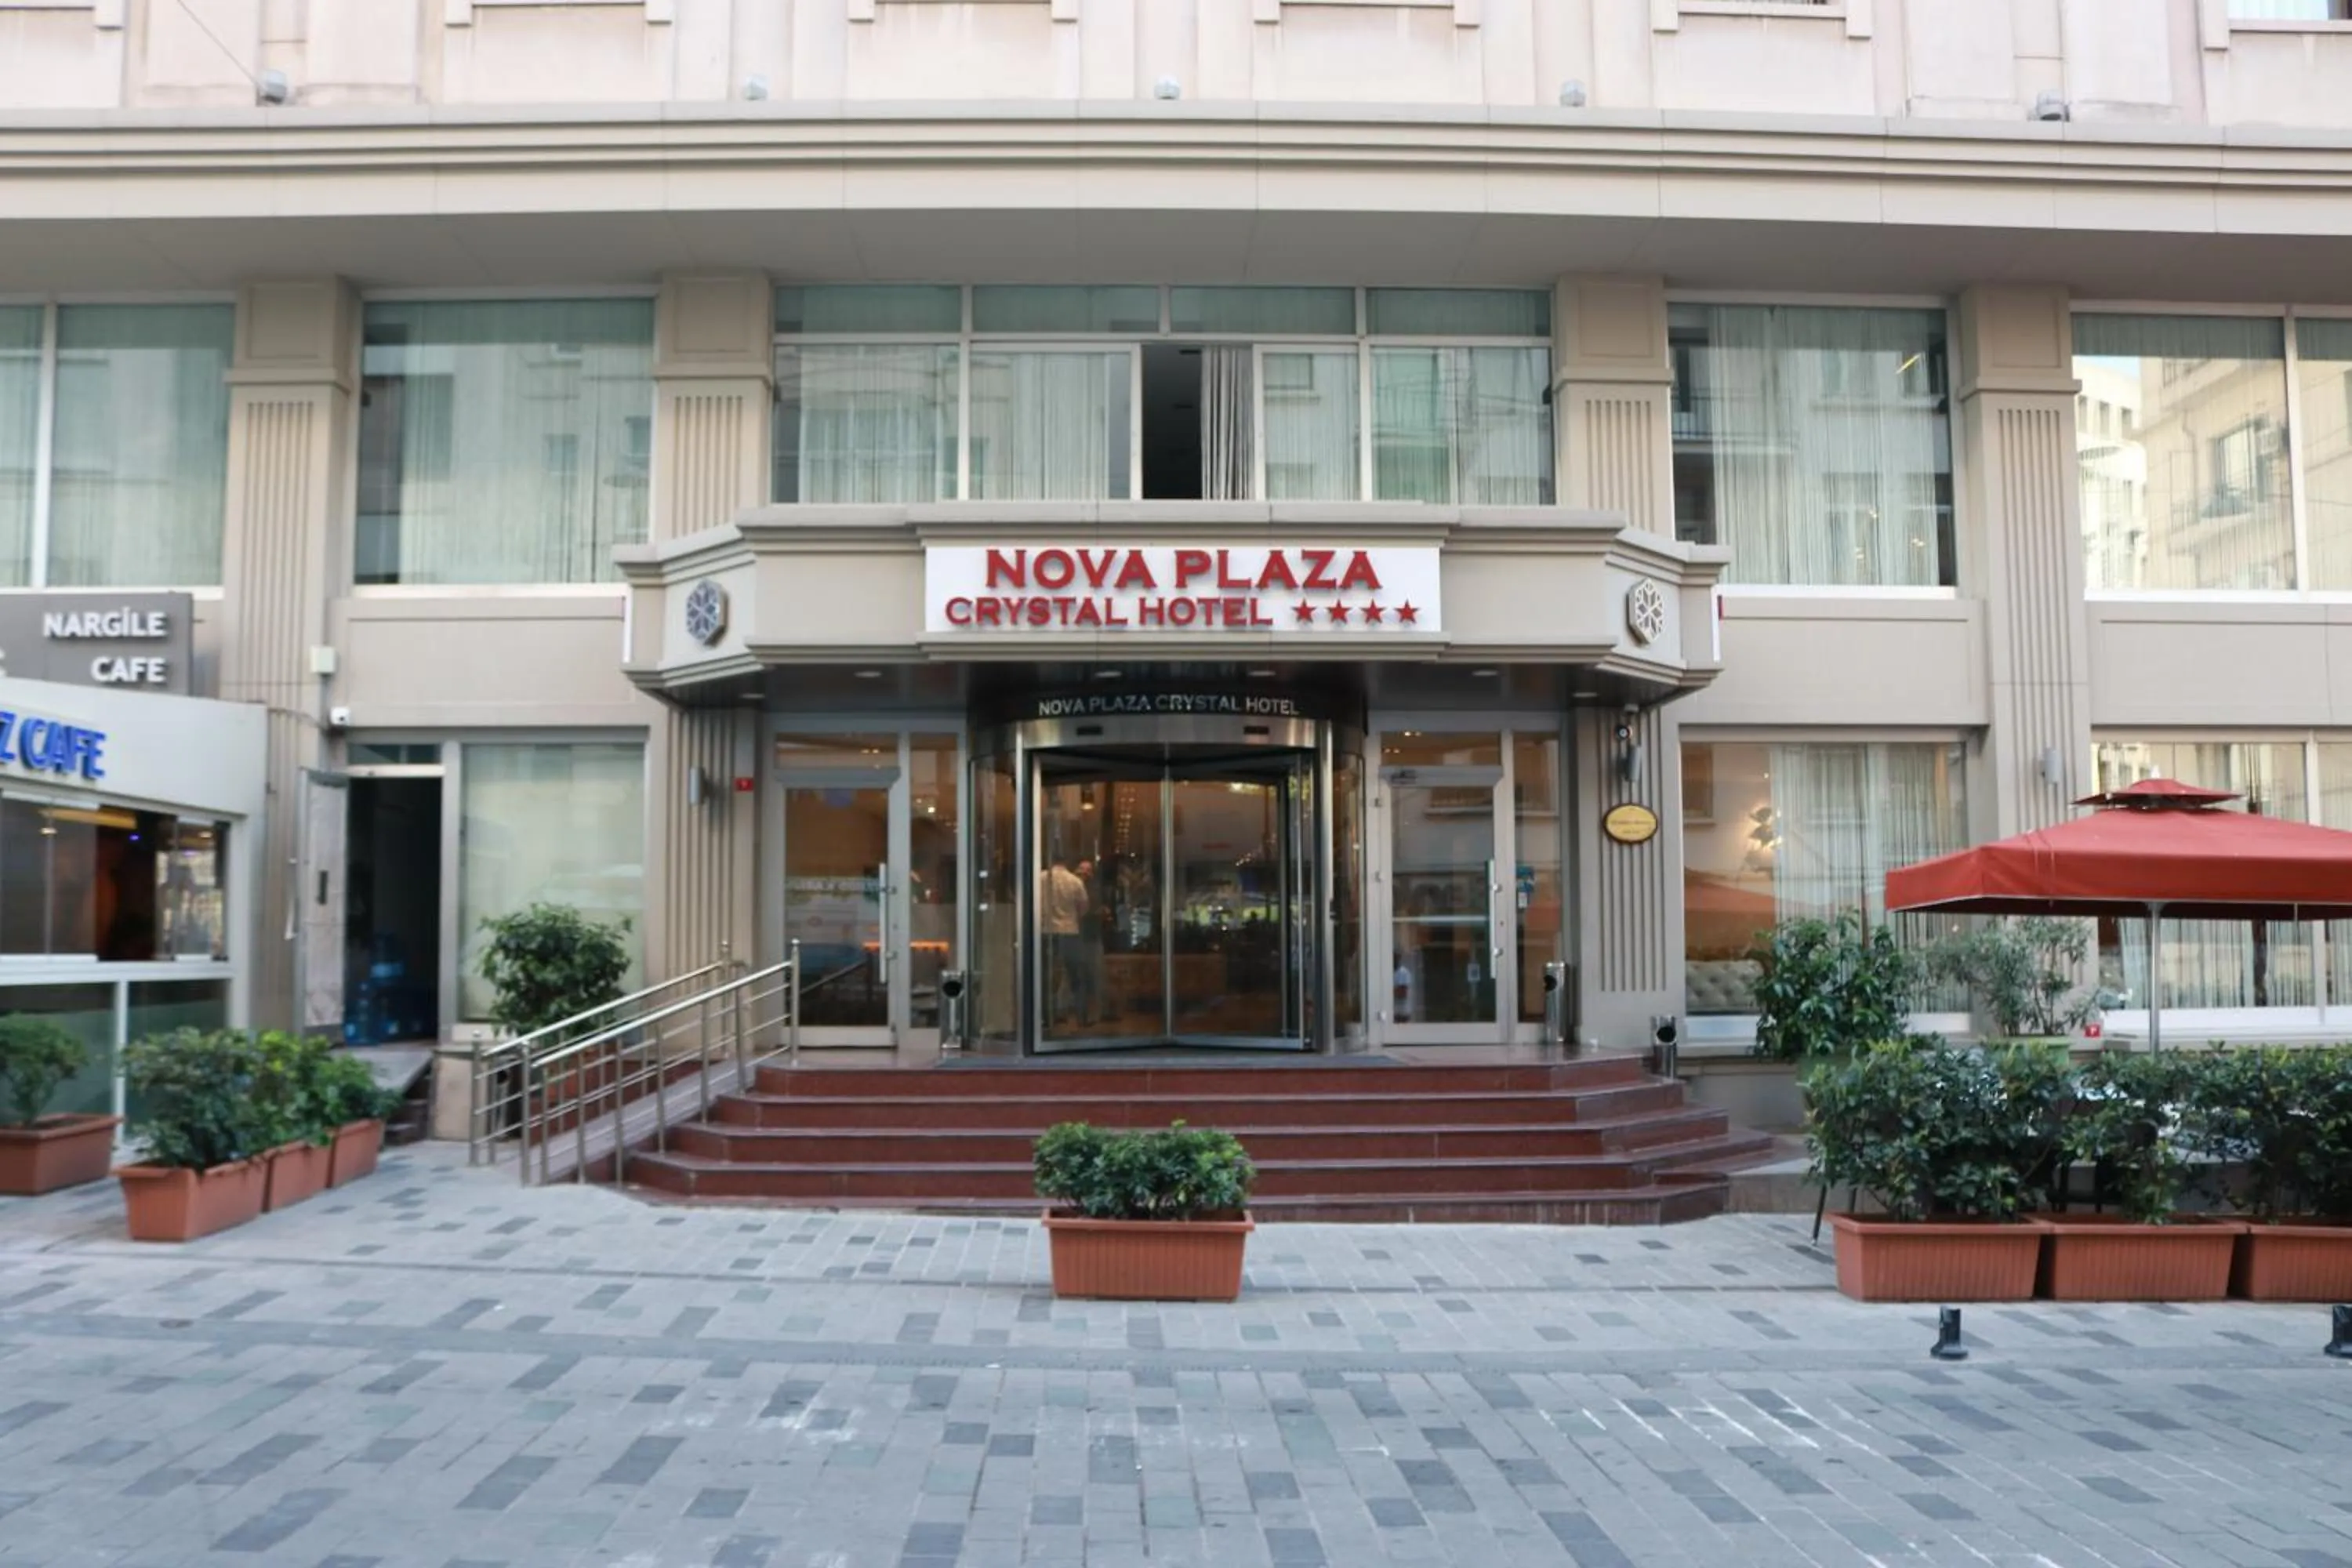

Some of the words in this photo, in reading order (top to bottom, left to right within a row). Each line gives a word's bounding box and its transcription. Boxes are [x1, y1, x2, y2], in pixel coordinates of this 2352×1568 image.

[985, 549, 1157, 589] NOVA
[1174, 550, 1382, 590] PLAZA
[43, 607, 167, 637] NARGİLE
[946, 597, 1128, 626] CRYSTAL
[1138, 597, 1273, 626] HOTEL
[90, 656, 167, 682] CAFE
[1039, 699, 1085, 716] NOVA
[1088, 695, 1151, 712] PLAZA
[1155, 694, 1240, 711] CRYSTAL
[1245, 697, 1299, 715] HOTEL
[20, 717, 106, 780] CAFE
